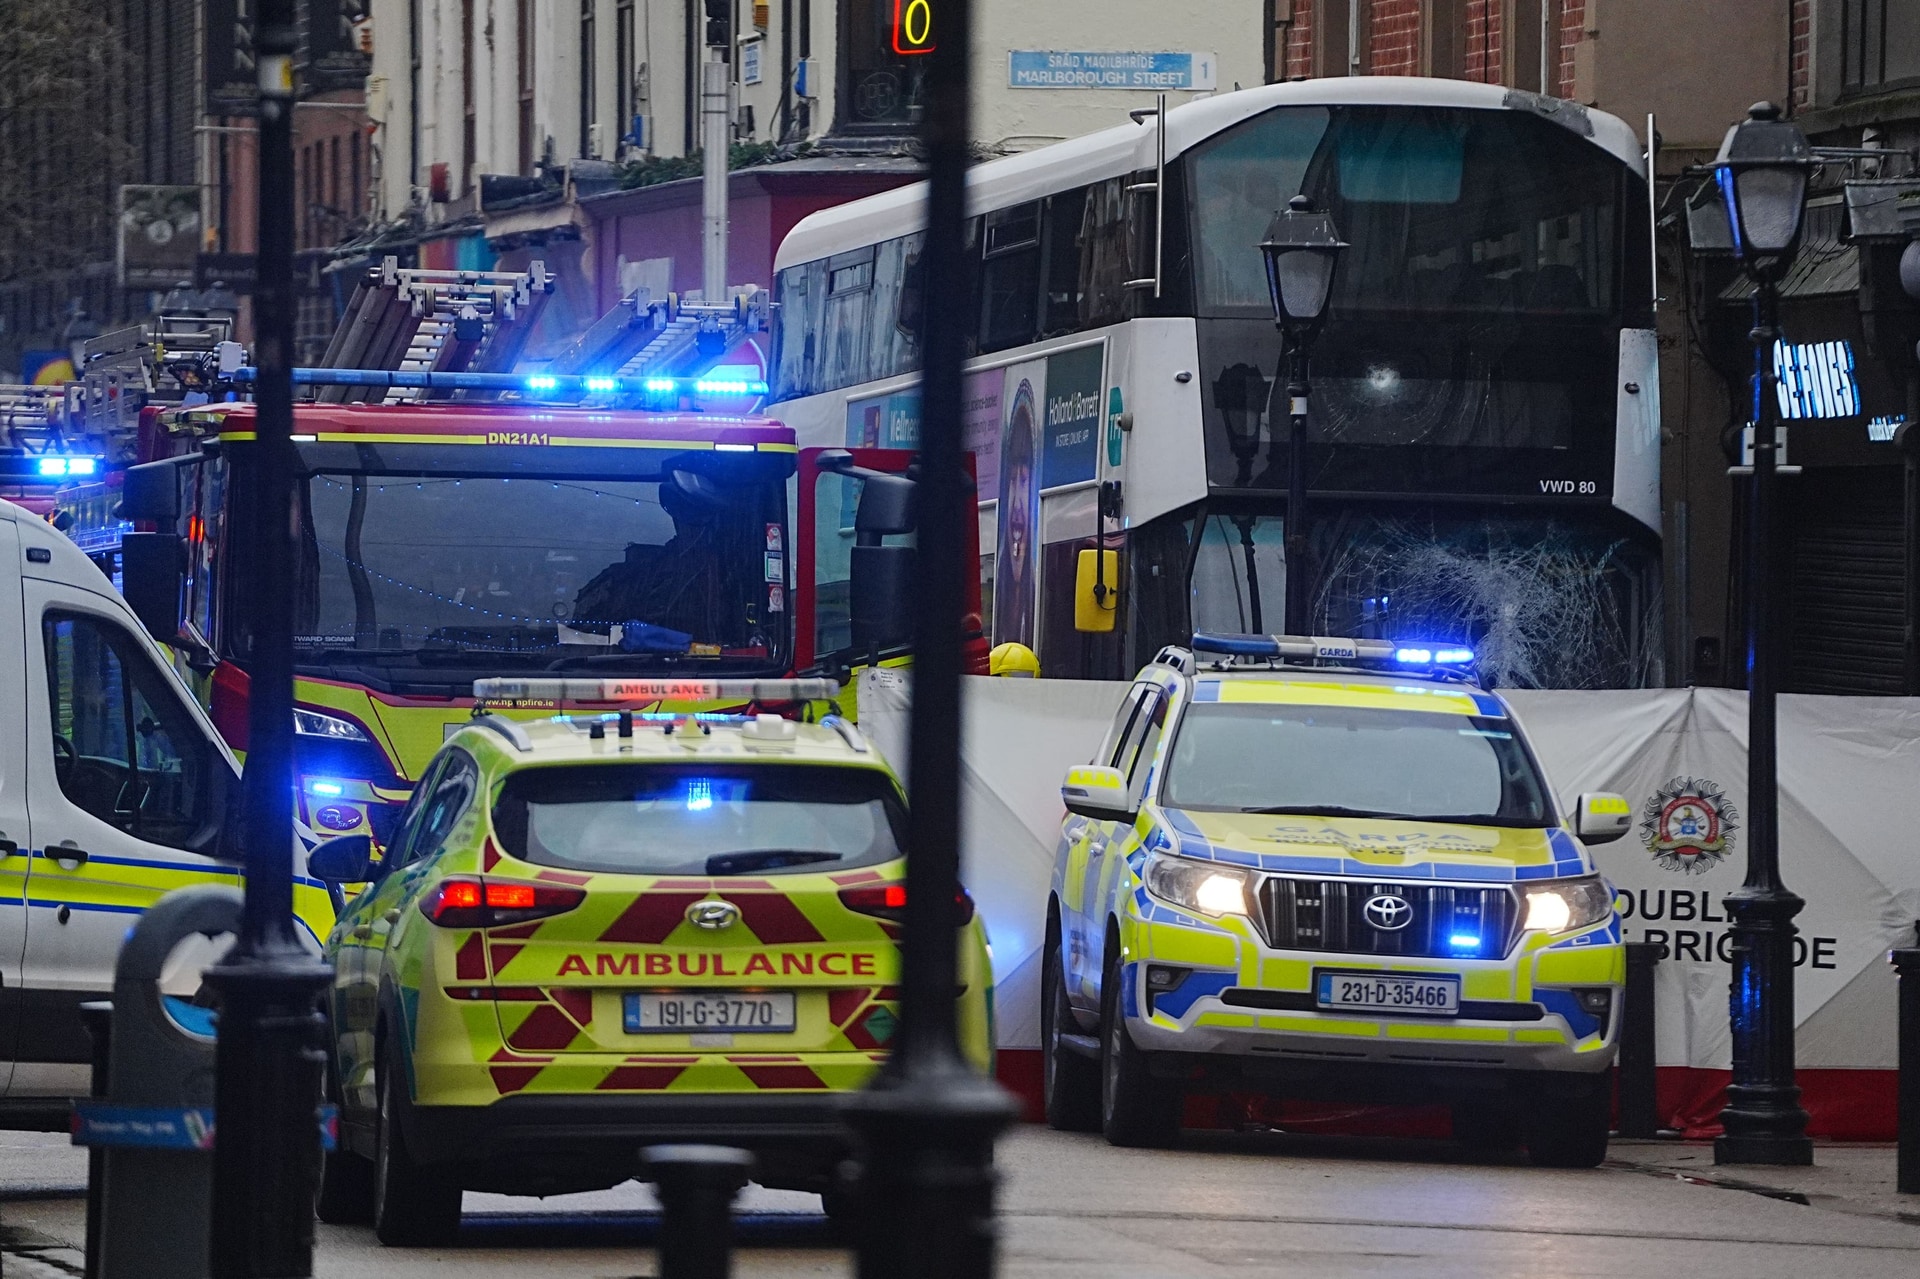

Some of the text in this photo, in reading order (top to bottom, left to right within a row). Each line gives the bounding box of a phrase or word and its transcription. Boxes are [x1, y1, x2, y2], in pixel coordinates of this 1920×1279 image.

[1017, 70, 1185, 85] MARLBOROUGH STREET
[1200, 62, 1209, 79] 1
[488, 432, 548, 445] DN21A1
[1540, 480, 1596, 494] VWD 80
[1319, 647, 1354, 657] GARDA
[614, 684, 711, 695] AMBULANCE
[1275, 826, 1472, 842] GARDA
[556, 953, 876, 976] AMBULANCE
[1341, 982, 1447, 1006] 231-D-35466
[659, 1001, 773, 1026] 191-G-3770
